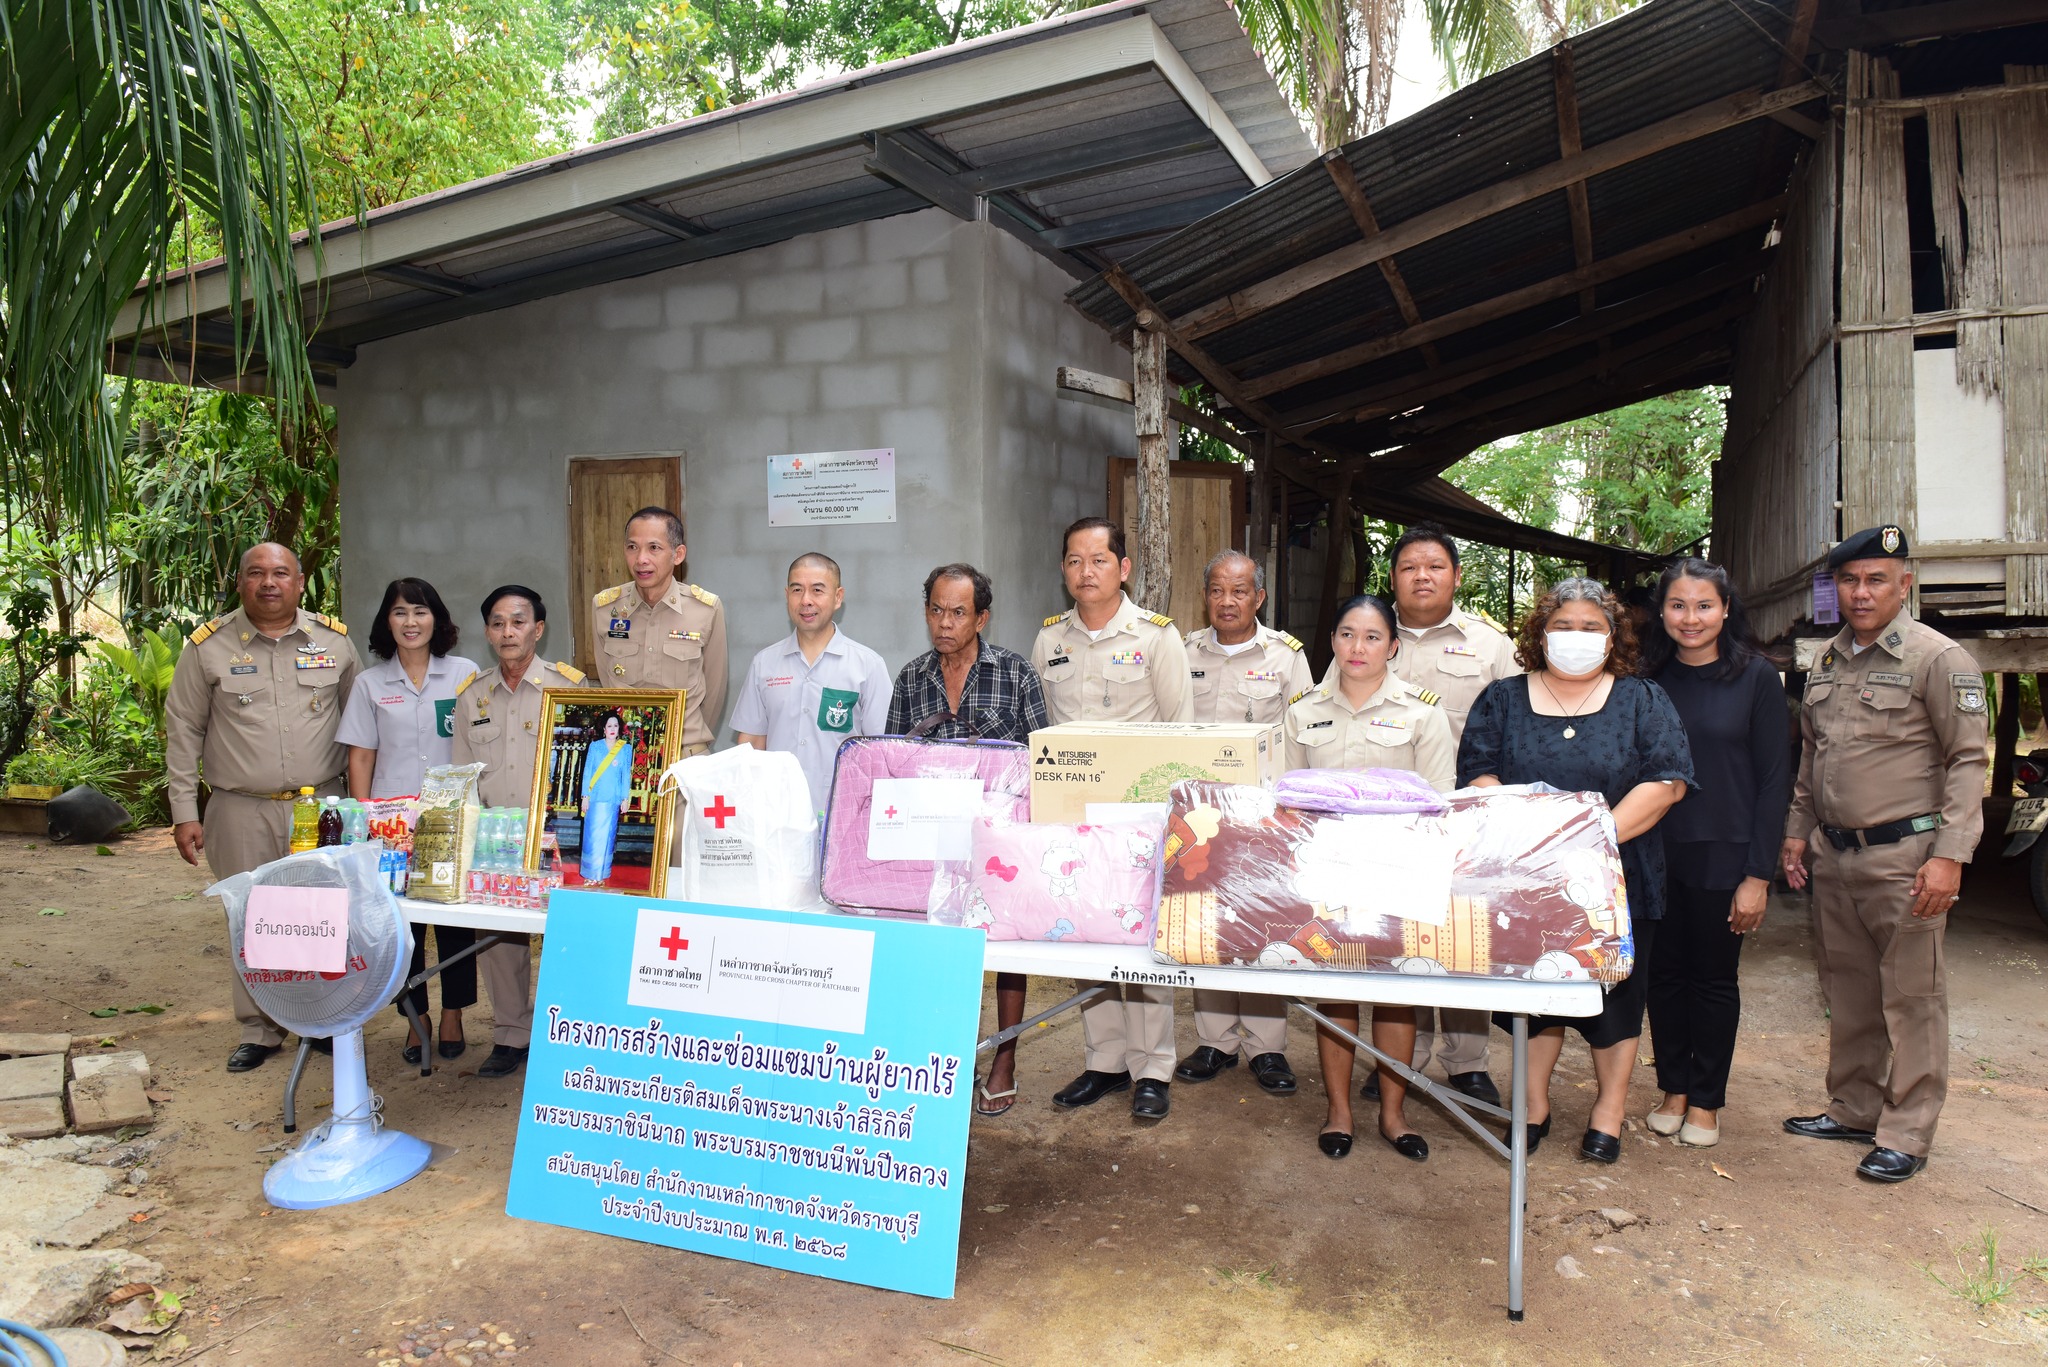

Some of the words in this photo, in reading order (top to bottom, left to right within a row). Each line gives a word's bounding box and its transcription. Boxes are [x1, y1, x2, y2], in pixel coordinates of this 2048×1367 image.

[846, 504, 859, 512] บาท
[1057, 750, 1097, 760] MITSUBISHI
[1057, 758, 1093, 766] ELECTRIC
[1034, 771, 1064, 782] DESK
[1065, 772, 1086, 782] FAN
[254, 917, 337, 938] อำเภอจอมบึง
[639, 965, 702, 982] สภากาชาดไทย
[719, 956, 834, 982] เหล่ากาชาดจังหวัดราชบุรี
[718, 970, 754, 981] PROVINCIAL
[754, 974, 766, 982] RED
[767, 975, 785, 984] CROSS
[785, 977, 812, 987] CHAPTER
[813, 980, 821, 988] OF
[821, 981, 860, 993] RATCHABURI
[548, 1006, 959, 1100] โครงการสร้างและซ่อมแซมบ้านผู้ยากไร้
[563, 1065, 917, 1140] เฉลิมพระเกียรติสมเด็จพระนางเจ้าสิริกิติ์
[533, 1104, 686, 1145] พระบรมราชินีนาถ
[692, 1130, 949, 1188] พระบรมราชชนนีพันปีหลวง
[547, 1153, 640, 1186] สนับสนุนโดย
[645, 1168, 920, 1241] สำนักงานเหล่ากาชาดจังหวัดราชบุรี
[602, 1196, 749, 1240] ประจำปีงบประมาณ
[755, 1226, 788, 1248] พ.ศ.
[794, 1234, 847, 1259] ๒๕๖๘
